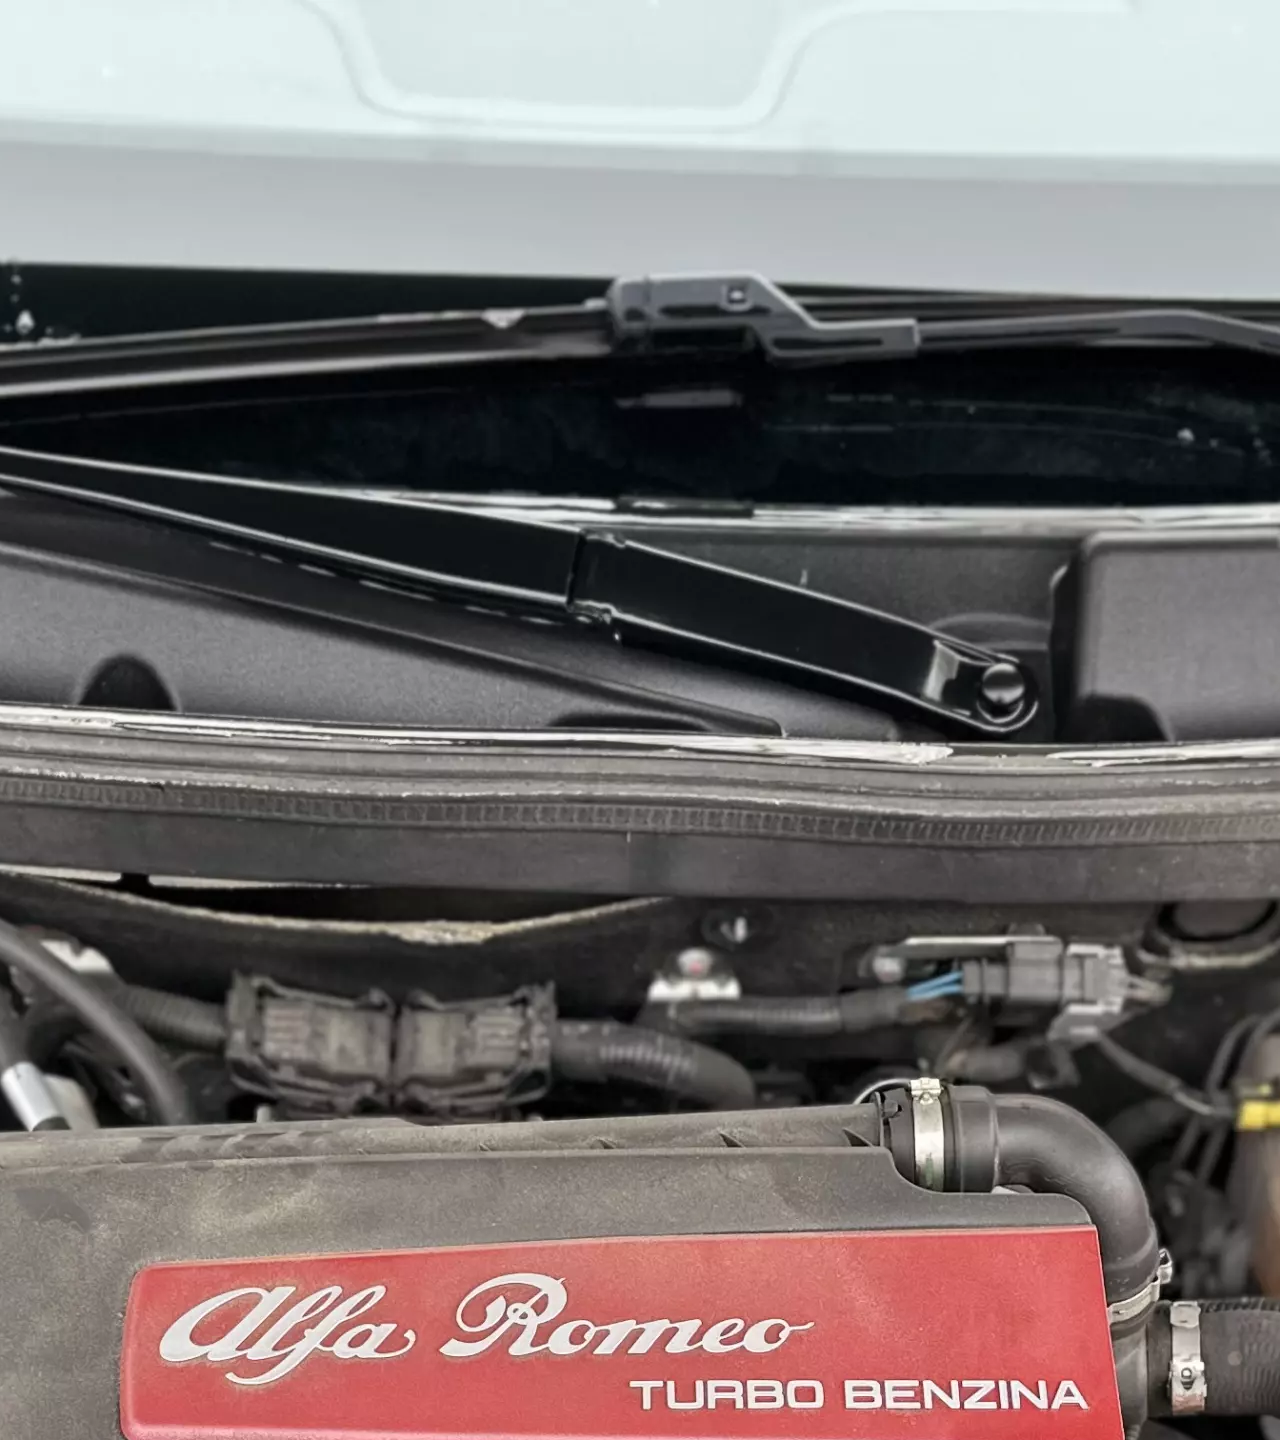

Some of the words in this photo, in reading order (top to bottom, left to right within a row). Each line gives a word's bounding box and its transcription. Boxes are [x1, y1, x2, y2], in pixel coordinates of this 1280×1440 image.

[158, 1285, 416, 1387] Alfa
[438, 1272, 816, 1359] Romeo
[629, 1380, 824, 1412] TURBO
[842, 1379, 1091, 1412] BENZINA
